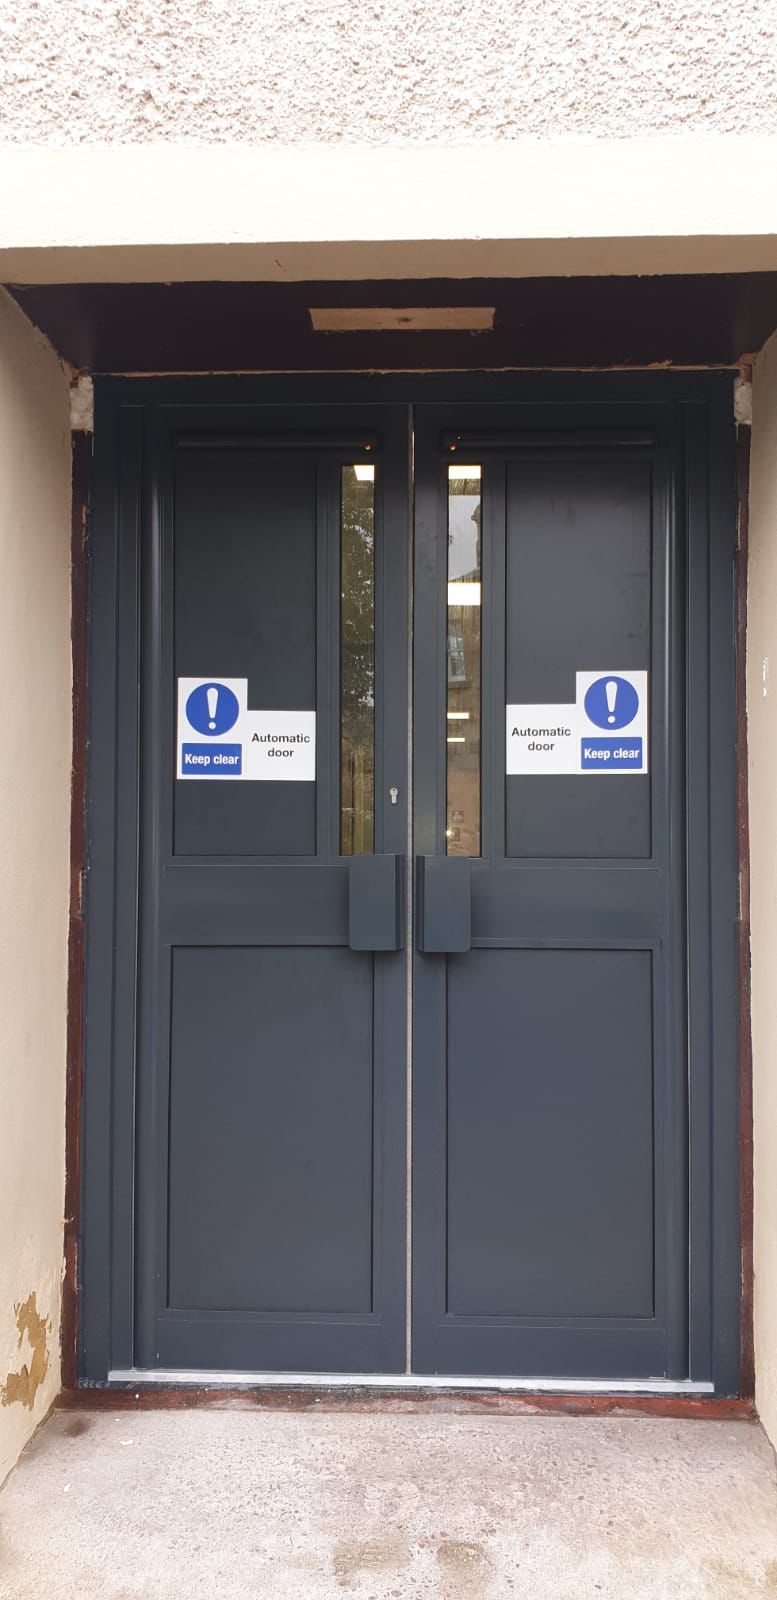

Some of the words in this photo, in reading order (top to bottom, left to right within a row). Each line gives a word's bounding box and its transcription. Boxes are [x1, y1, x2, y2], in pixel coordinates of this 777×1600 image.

[511, 727, 571, 737] Automatic
[251, 733, 310, 743] Automatic
[528, 742, 555, 751] door
[267, 748, 294, 757] door
[584, 748, 610, 760] Keep
[613, 748, 639, 759] clear
[184, 753, 211, 766] Keep
[213, 754, 239, 765] clear
